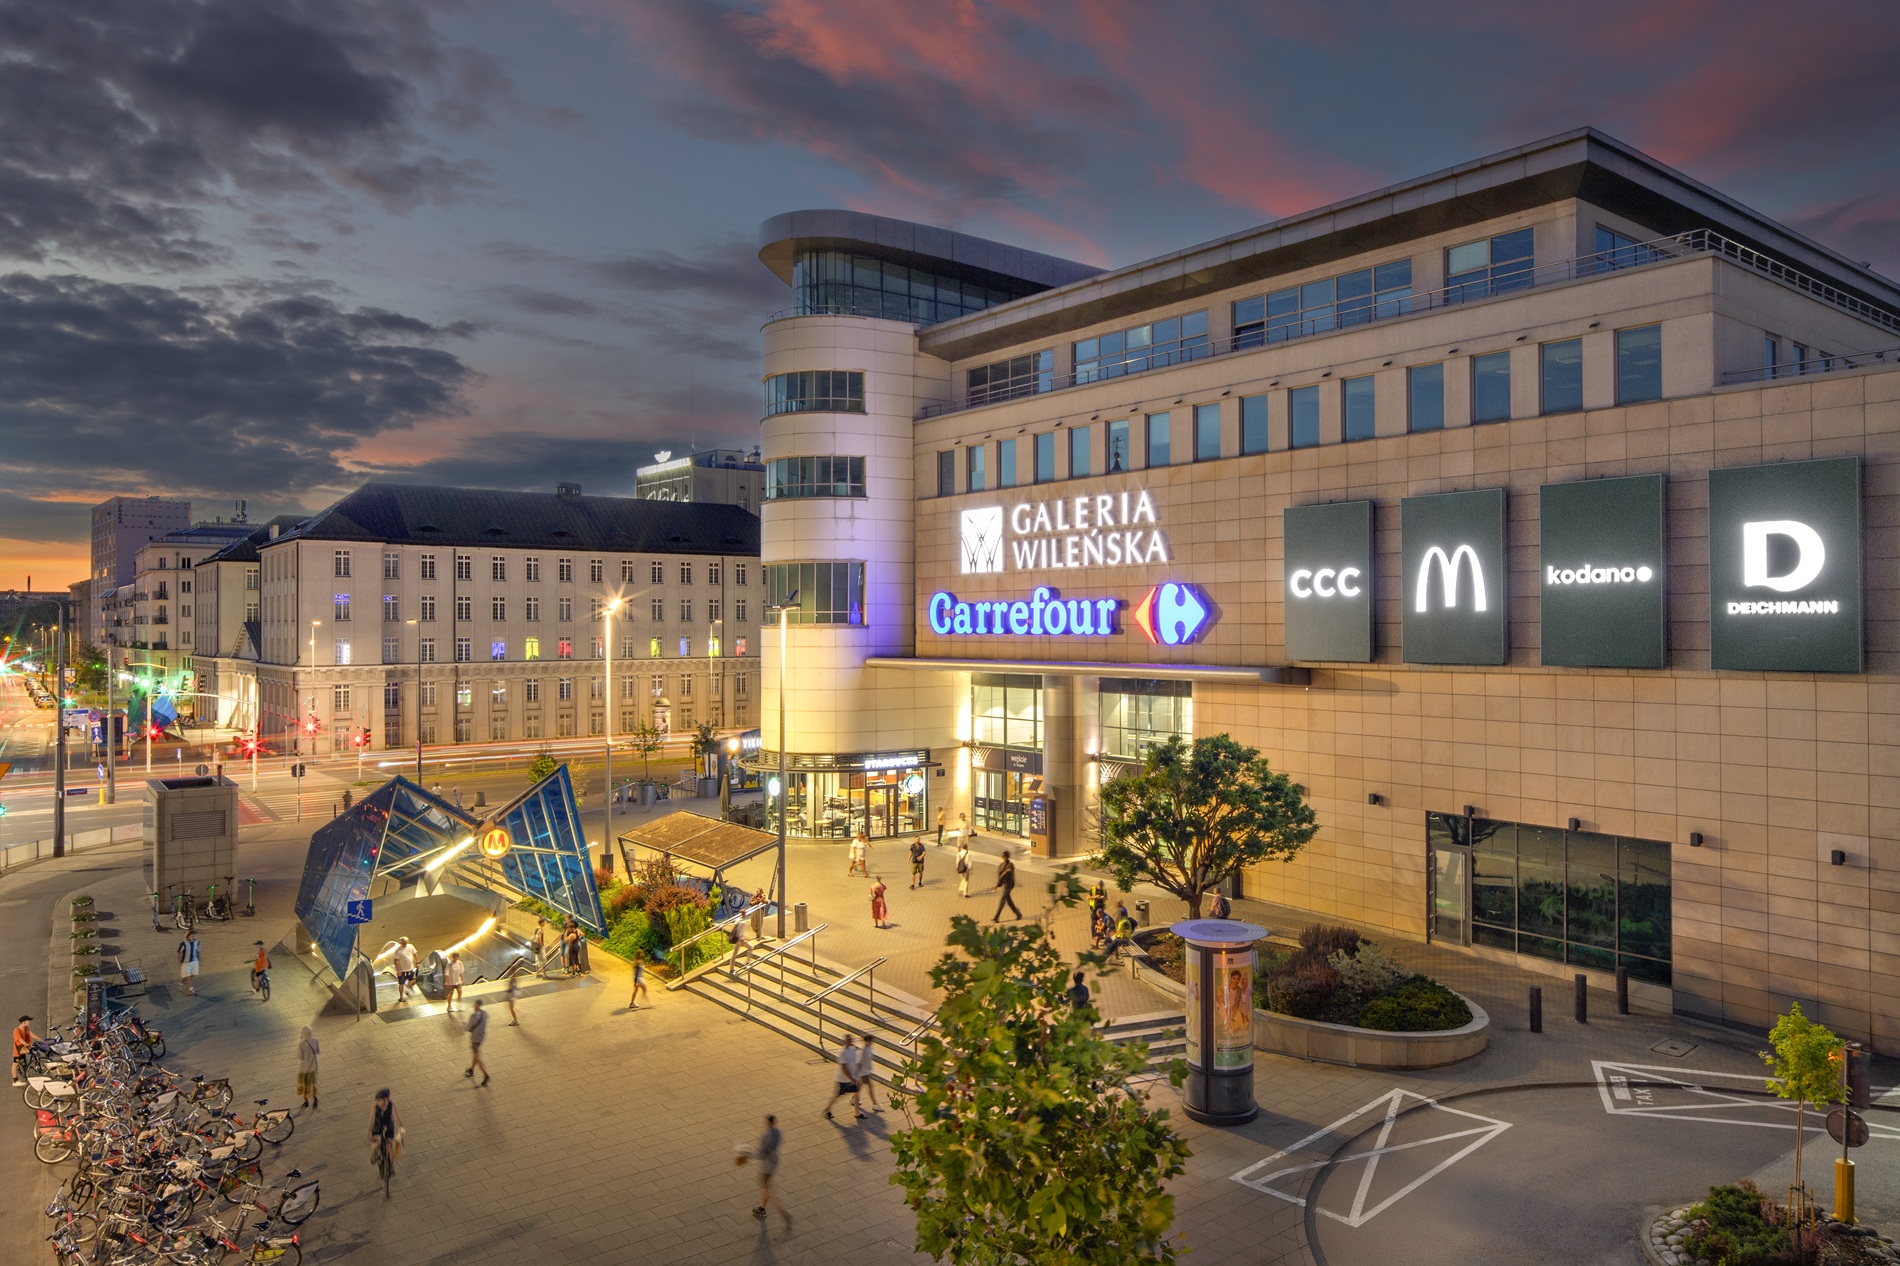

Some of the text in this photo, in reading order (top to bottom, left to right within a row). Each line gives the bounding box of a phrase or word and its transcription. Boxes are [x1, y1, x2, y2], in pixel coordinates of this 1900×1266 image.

[1012, 490, 1156, 535] GALERIA
[1012, 529, 1168, 570] WILEŃSKA
[1743, 520, 1825, 592] D
[929, 586, 1119, 635] Carrefour
[1727, 600, 1839, 614] DEICHMANN
[864, 755, 919, 769] STARBUCKS
[487, 833, 506, 850] M
[1630, 1078, 1654, 1106] TAXI
